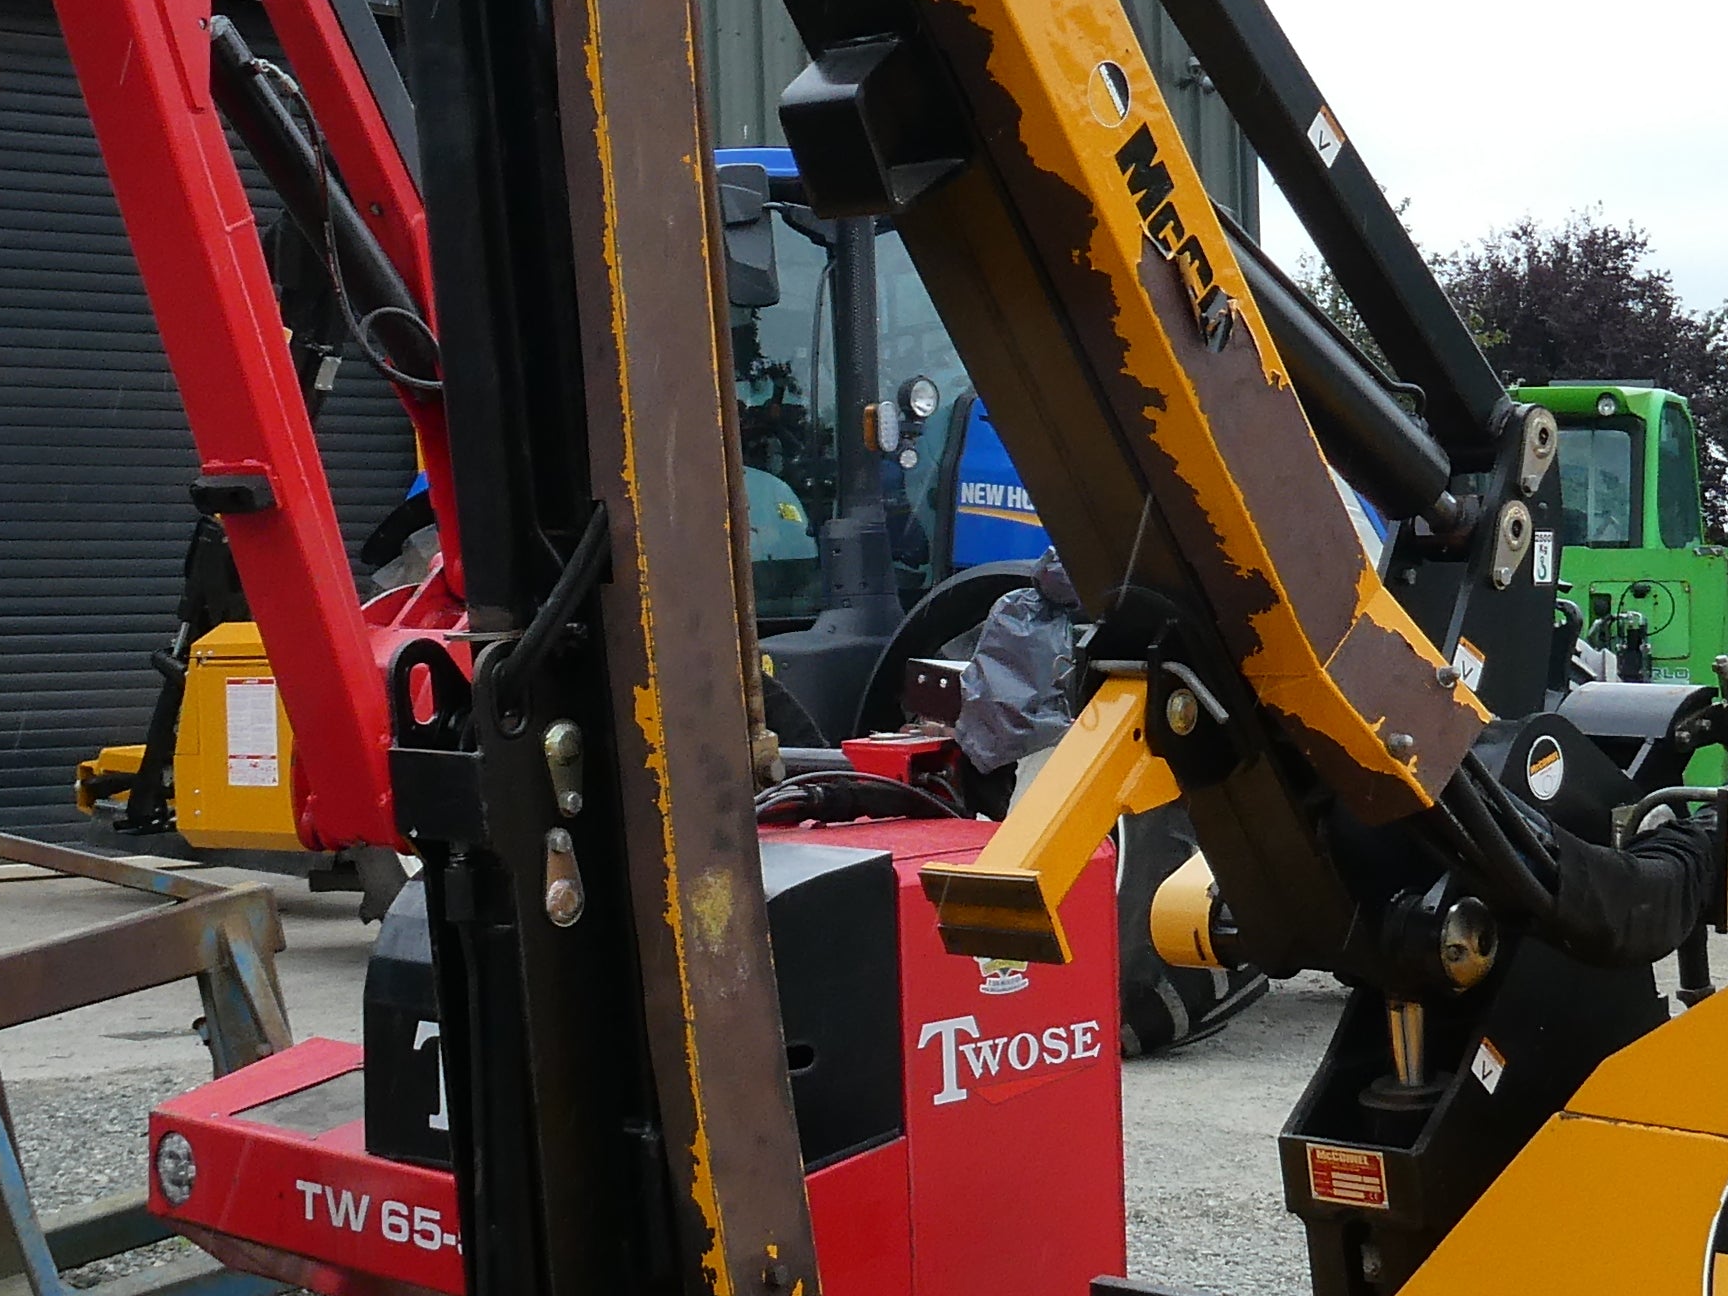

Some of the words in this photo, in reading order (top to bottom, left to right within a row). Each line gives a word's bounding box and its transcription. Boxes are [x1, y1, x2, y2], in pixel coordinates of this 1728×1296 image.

[960, 482, 1005, 506] NEW
[296, 1179, 370, 1233] TW
[381, 1200, 463, 1255] 65-
